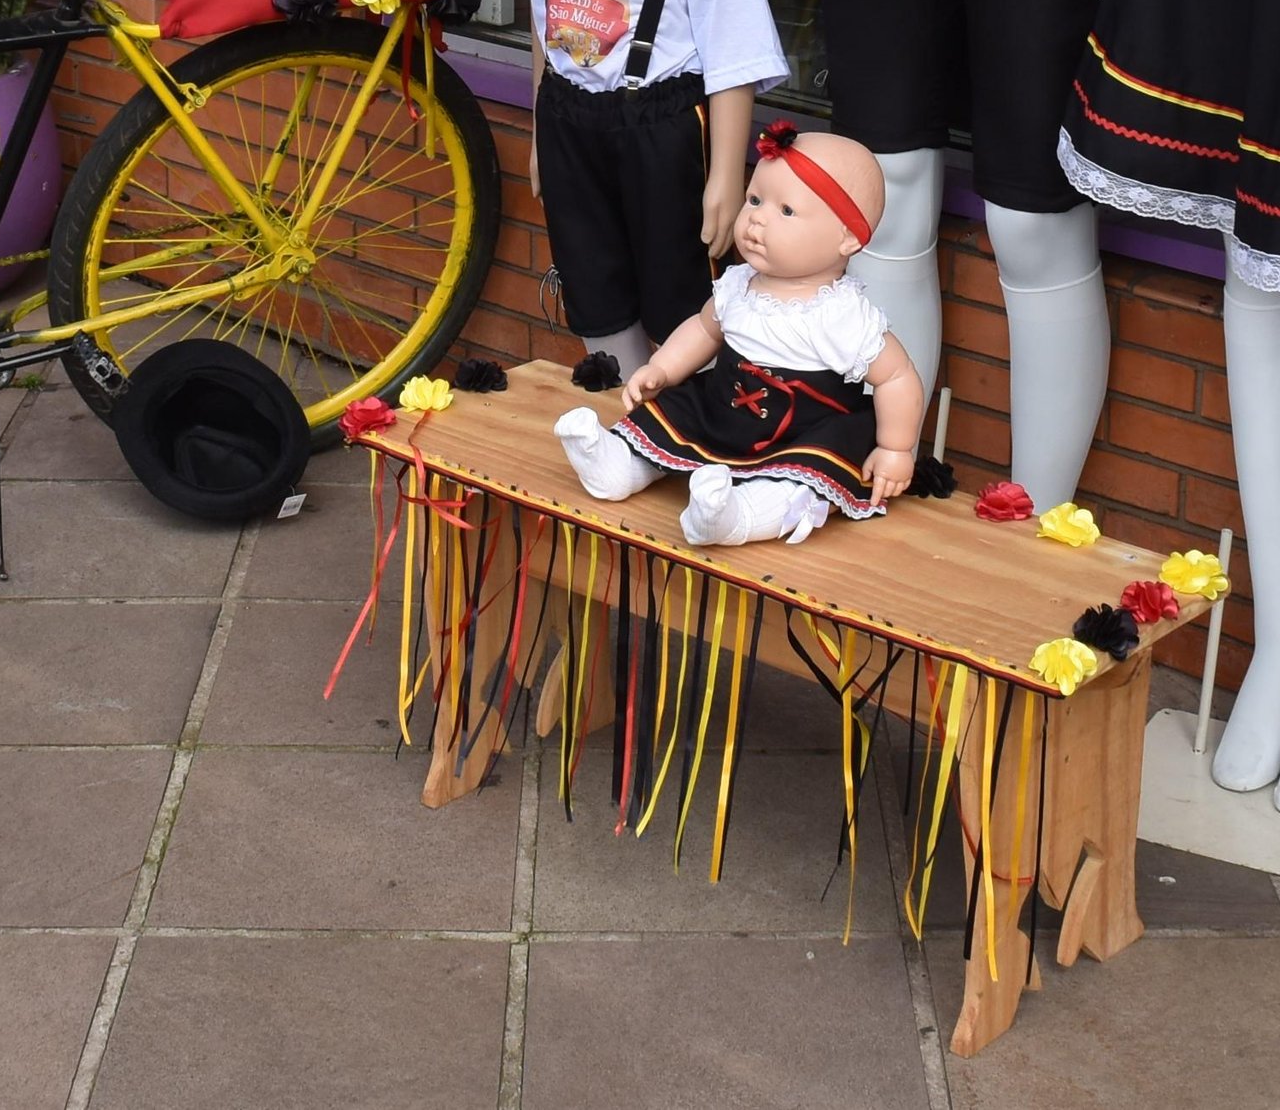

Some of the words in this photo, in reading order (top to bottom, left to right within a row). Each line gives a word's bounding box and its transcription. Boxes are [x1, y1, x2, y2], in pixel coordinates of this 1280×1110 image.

[592, 0, 605, 14] de
[549, 4, 569, 20] São
[570, 8, 616, 35] Miguel
